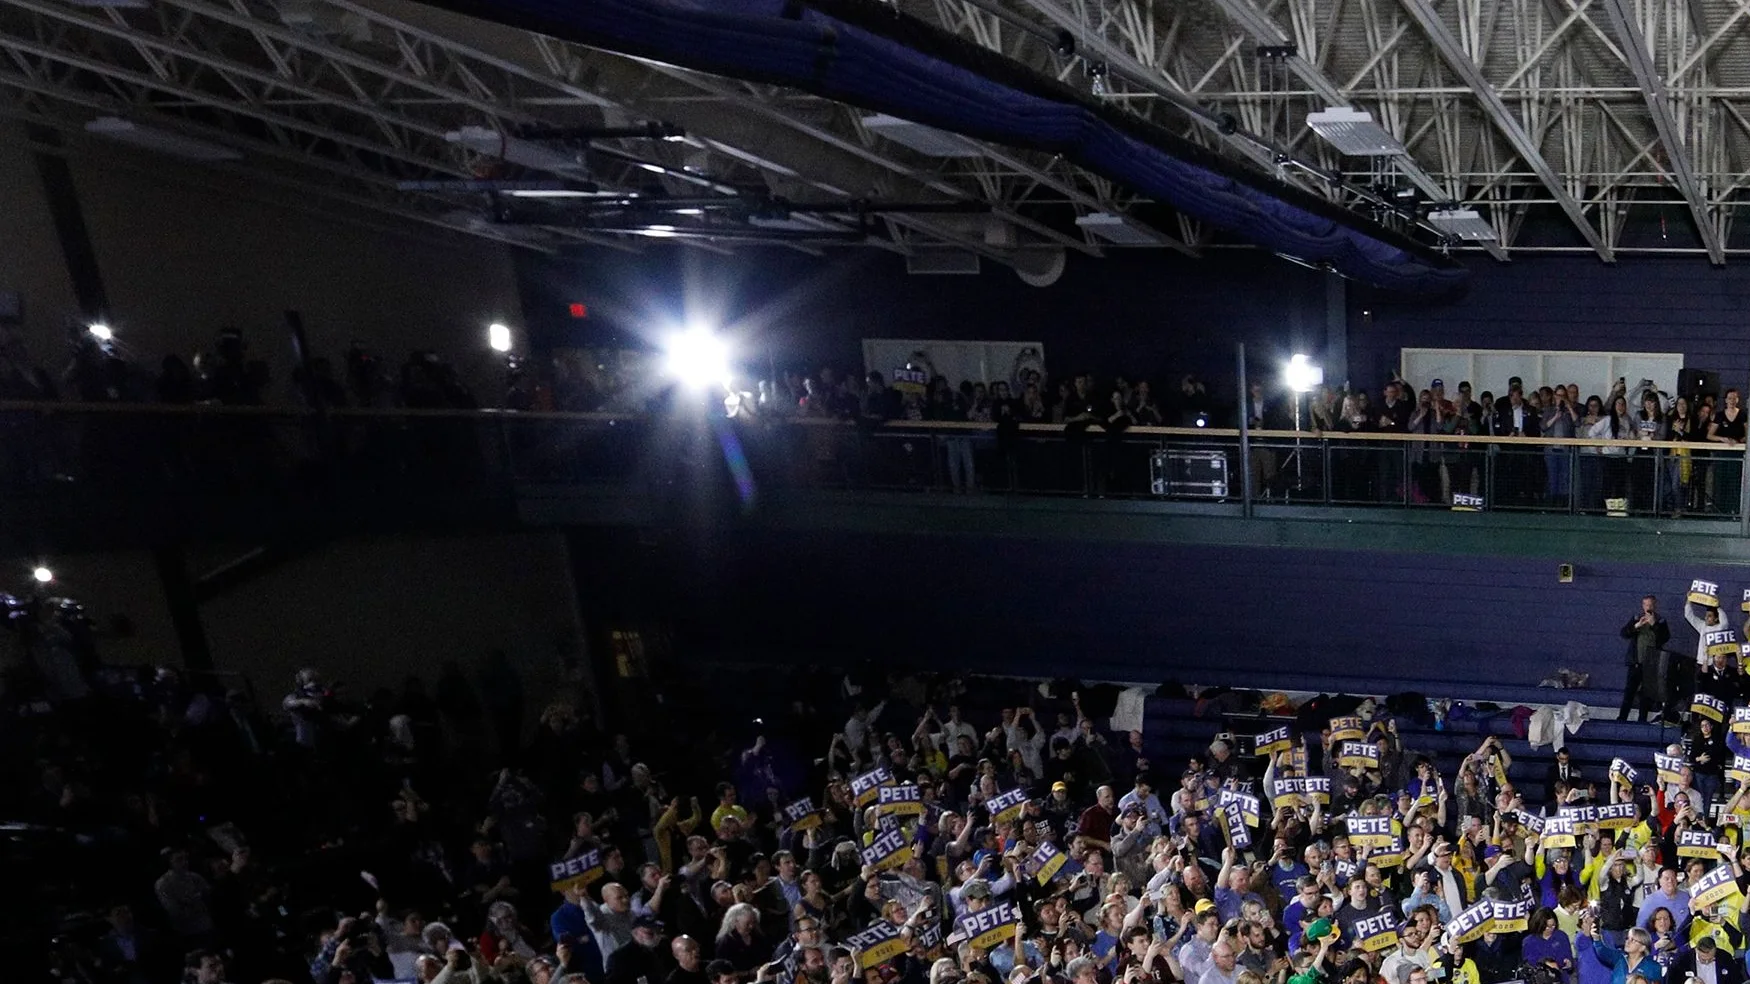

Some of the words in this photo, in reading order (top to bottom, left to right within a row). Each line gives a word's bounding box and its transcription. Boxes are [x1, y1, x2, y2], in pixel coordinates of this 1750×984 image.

[1691, 580, 1718, 596] PETE
[1706, 631, 1736, 645] PETE
[1330, 716, 1363, 730] PETE
[1255, 726, 1287, 746] PETE
[1343, 742, 1376, 757] PETE
[852, 767, 888, 796] PETE
[880, 786, 920, 801] PETE
[987, 788, 1026, 814] PETE
[1598, 804, 1634, 819] PETE
[1226, 803, 1248, 848] PETE
[1348, 818, 1390, 834] PETE
[1544, 818, 1573, 835] PETE
[862, 829, 904, 866] PETE
[1035, 841, 1055, 862] TE
[551, 850, 601, 878] PETE
[1338, 861, 1358, 876] PE
[1690, 867, 1730, 897] PETE
[962, 903, 1012, 937] PETE
[1356, 912, 1394, 938] PETE
[1450, 901, 1492, 936] PETE
[850, 922, 897, 950] PETE
[1372, 936, 1390, 946] 2020
